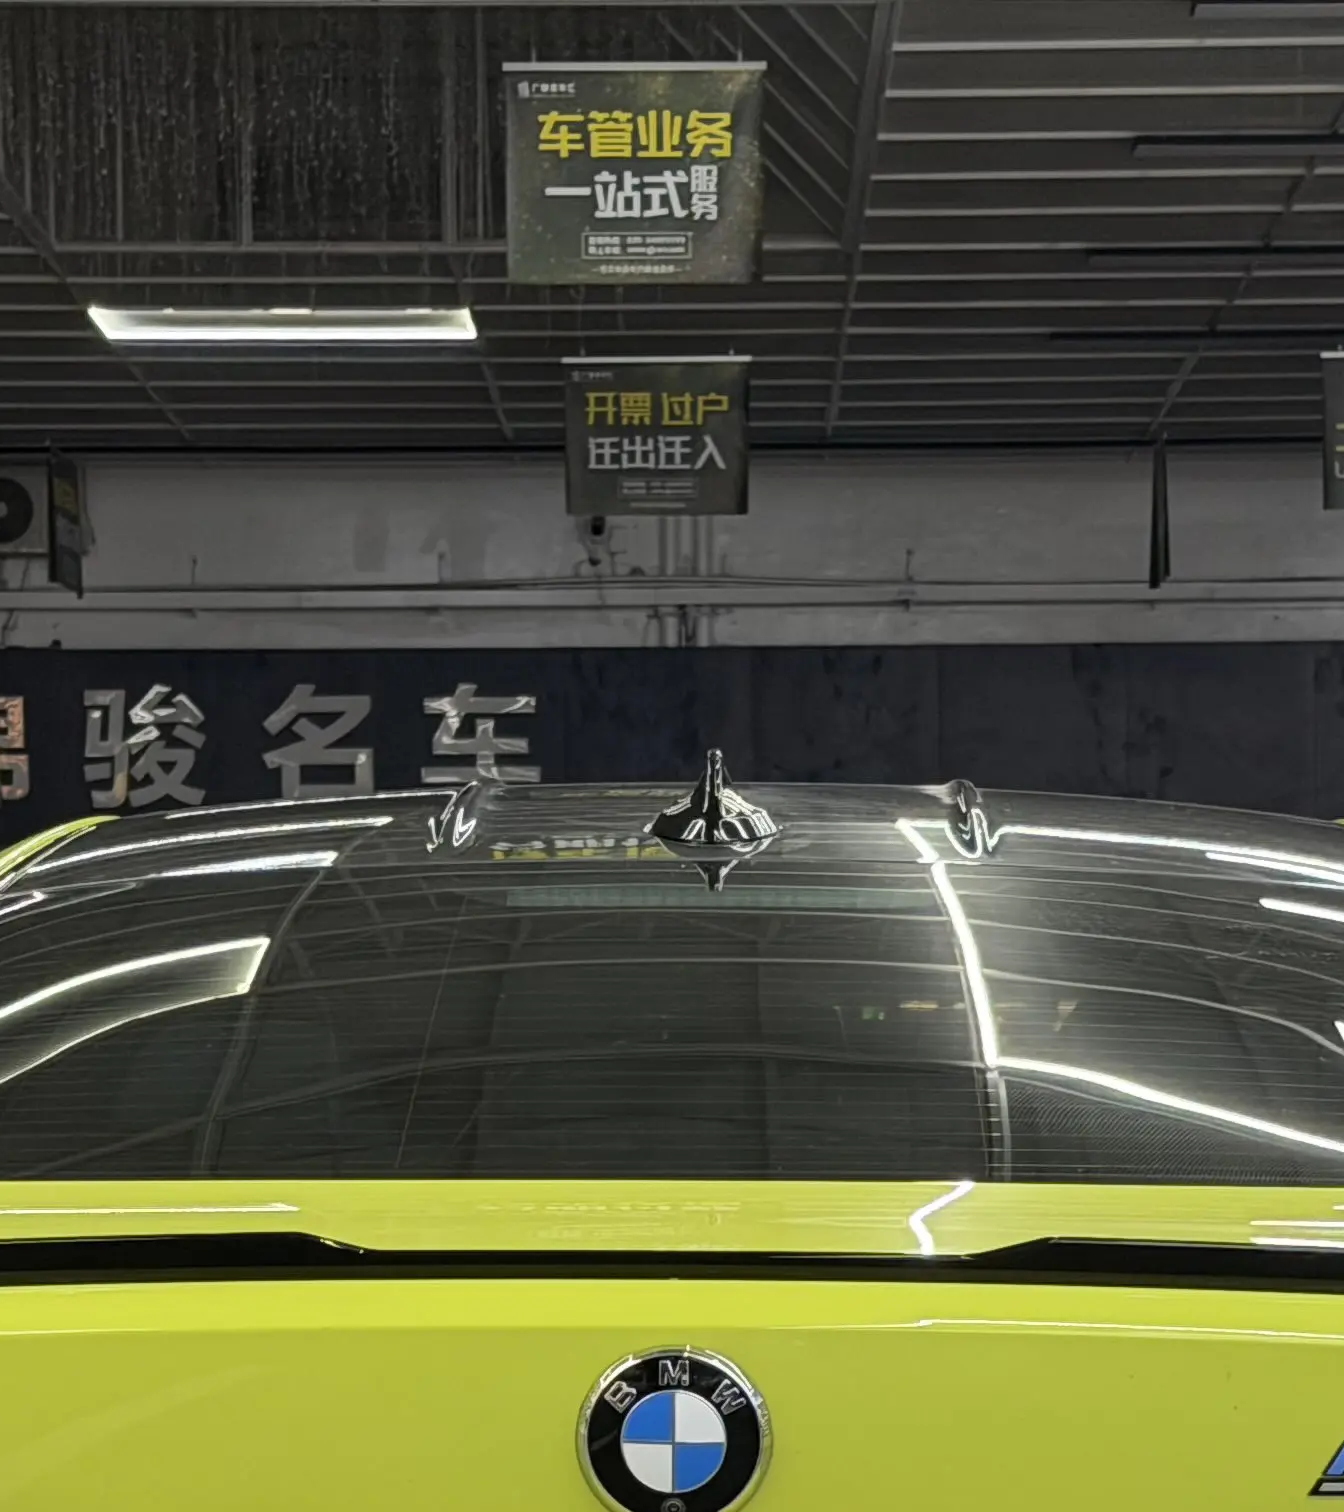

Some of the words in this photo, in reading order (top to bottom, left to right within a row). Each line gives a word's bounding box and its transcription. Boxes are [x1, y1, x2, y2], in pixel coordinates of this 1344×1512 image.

[537, 110, 733, 158] 车管业务
[587, 434, 727, 470] 迁出迁入
[603, 1358, 747, 1416] BMW
